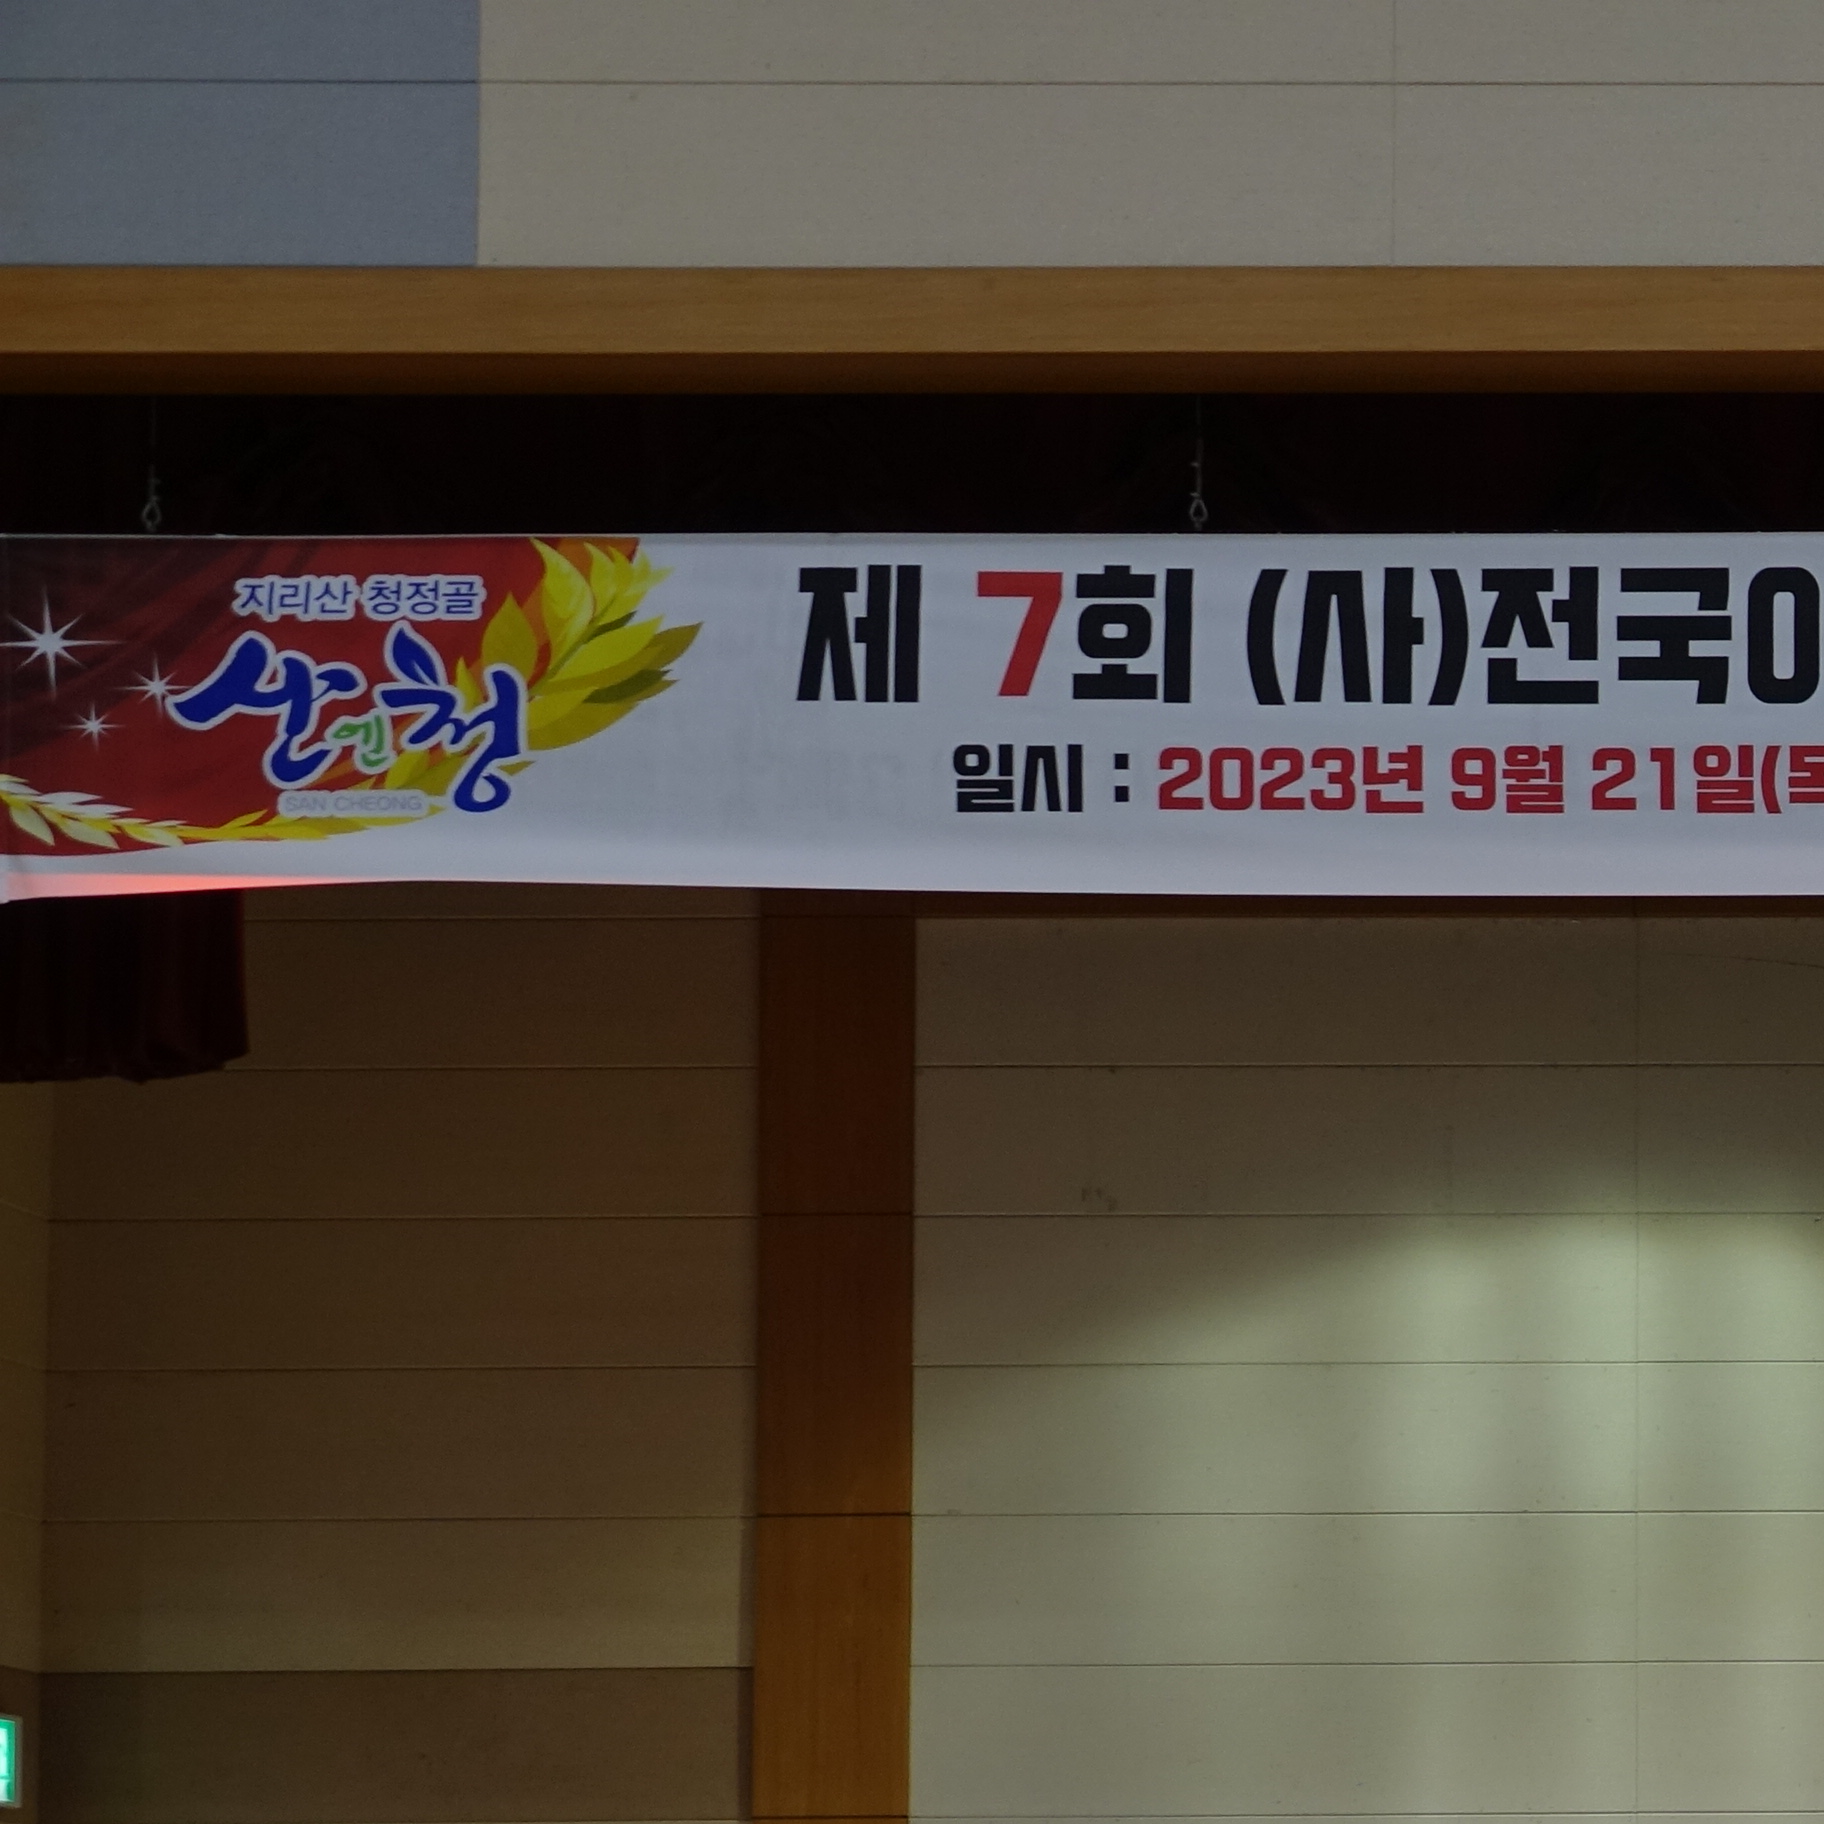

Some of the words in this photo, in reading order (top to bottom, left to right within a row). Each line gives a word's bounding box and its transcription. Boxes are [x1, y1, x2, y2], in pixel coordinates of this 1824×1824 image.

[237, 576, 356, 617] 지리산
[364, 574, 482, 617] 청정골
[797, 565, 921, 703] 제
[978, 565, 1193, 703] 7회
[285, 795, 326, 812] SAN
[334, 795, 423, 812] CHEONG
[953, 744, 1082, 813] 일시
[1159, 745, 1424, 814] 2023년
[1451, 744, 1565, 814] 9월
